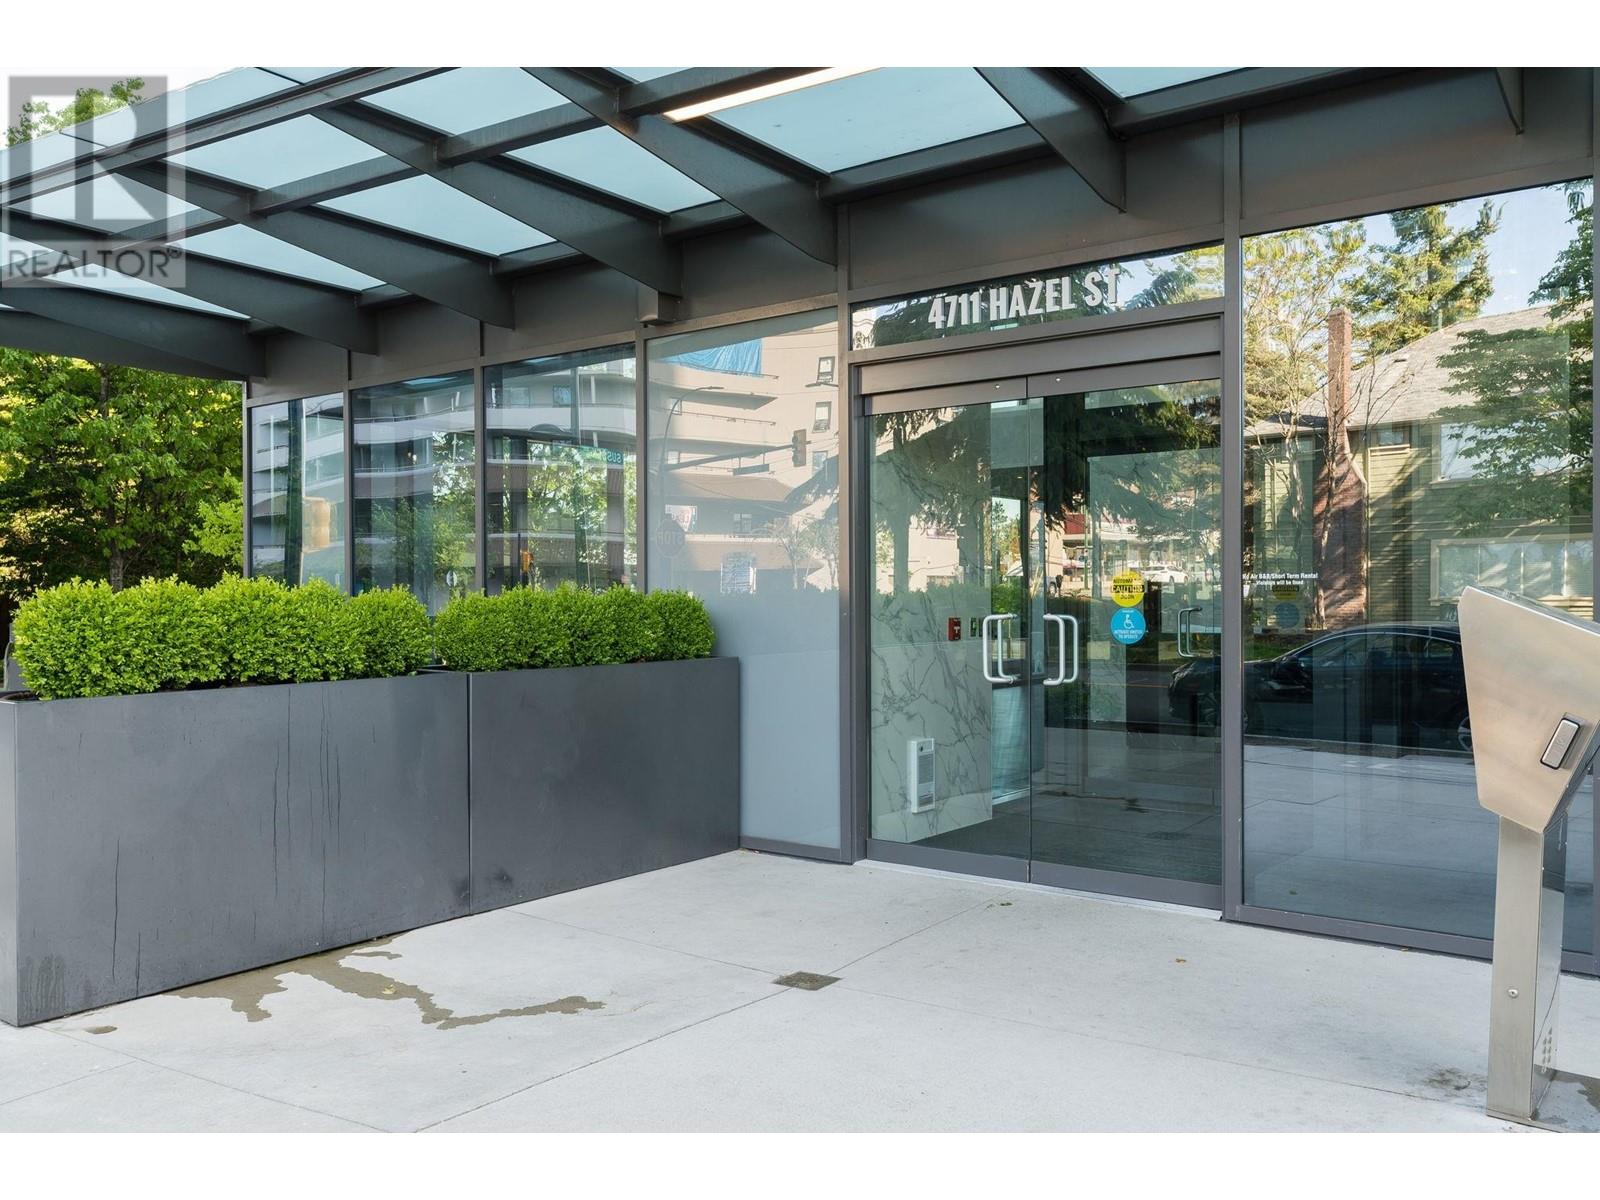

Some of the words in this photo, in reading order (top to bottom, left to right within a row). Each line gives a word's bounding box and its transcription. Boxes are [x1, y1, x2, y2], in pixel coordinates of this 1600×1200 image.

[928, 291, 982, 329] 4711
[989, 277, 1077, 321] HAZEL
[1084, 268, 1120, 306] ST
[1112, 585, 1143, 593] CAUTION
